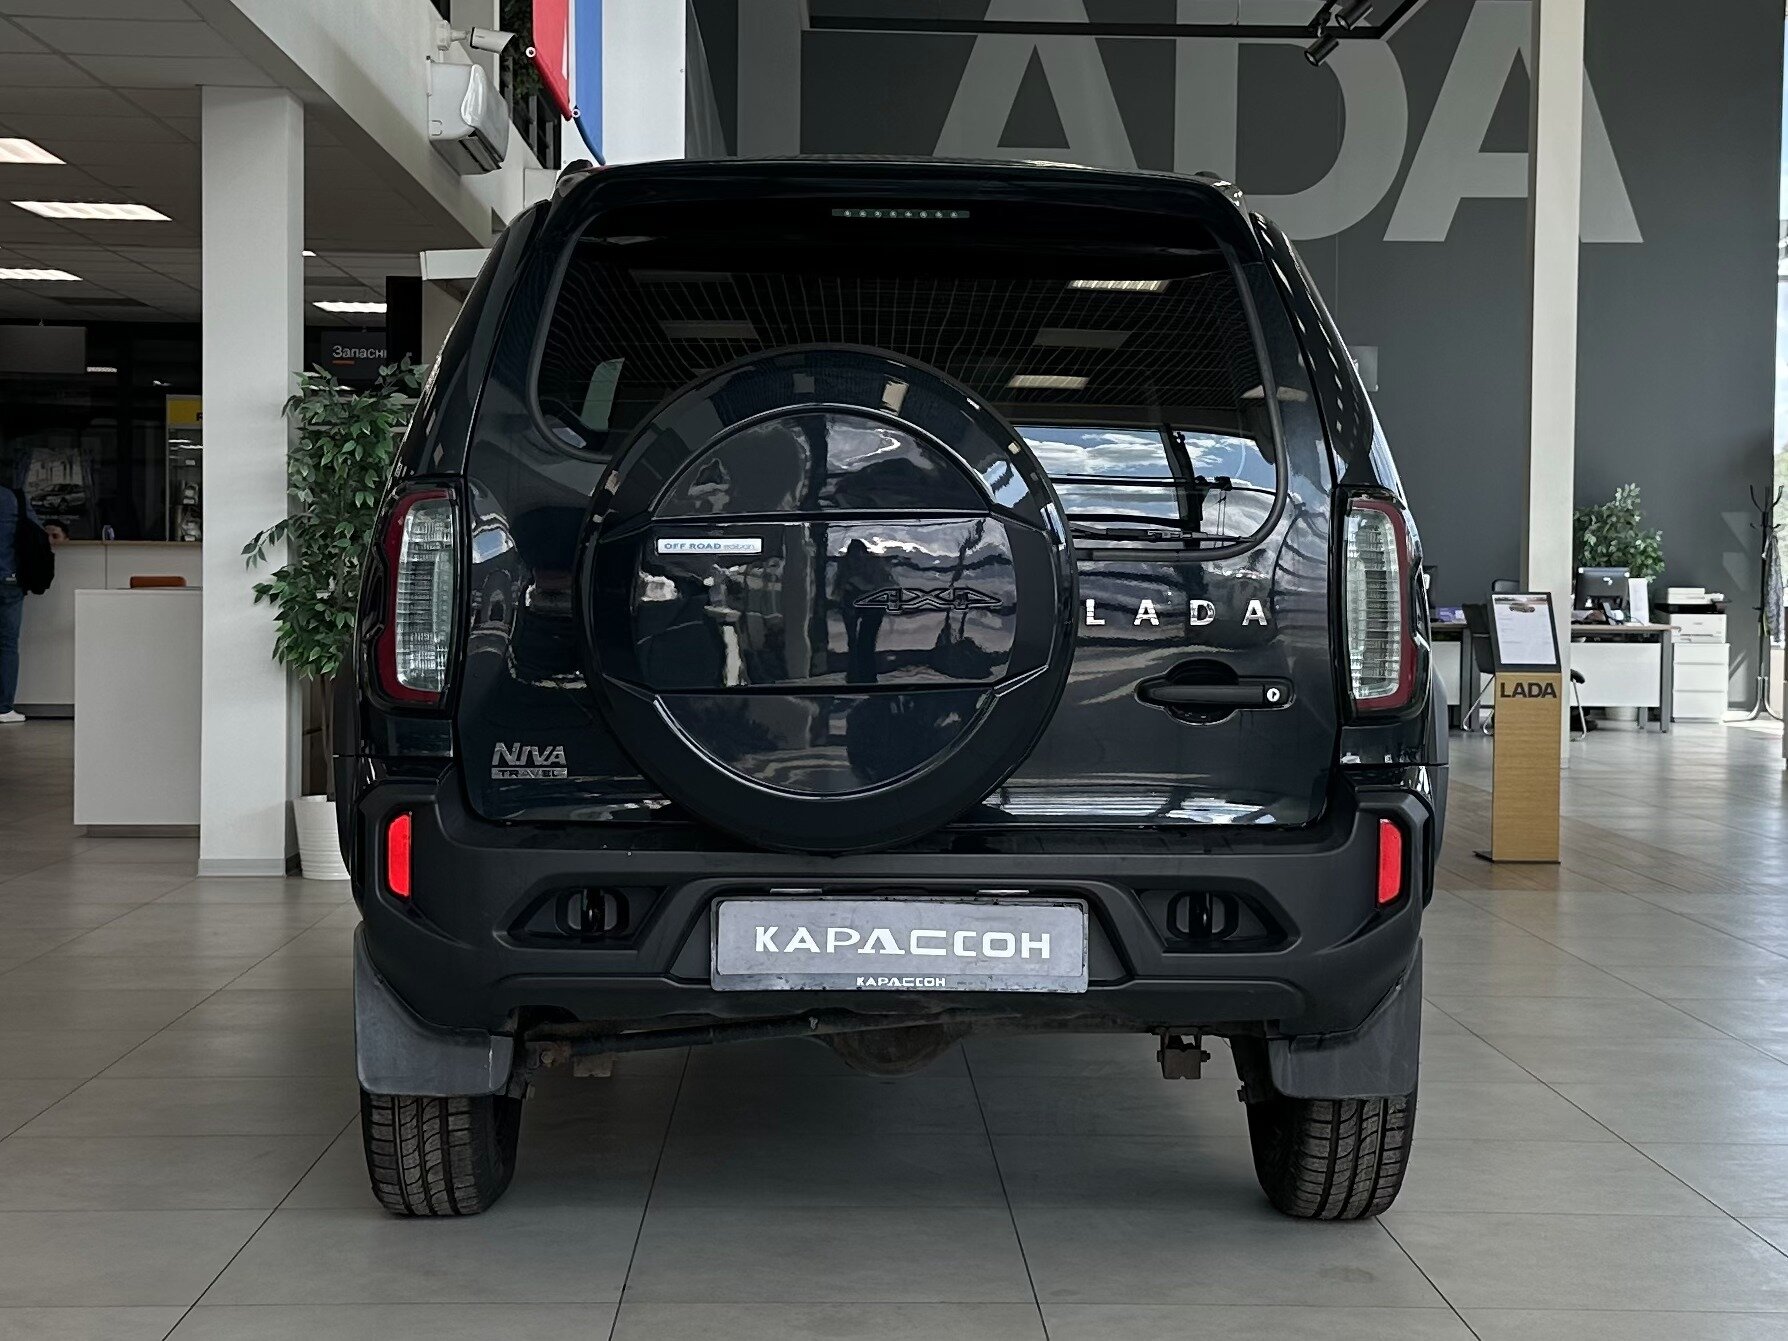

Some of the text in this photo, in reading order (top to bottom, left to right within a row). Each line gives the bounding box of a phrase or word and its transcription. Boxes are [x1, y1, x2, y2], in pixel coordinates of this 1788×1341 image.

[664, 542, 687, 550] OFF
[689, 542, 721, 550] ROAD
[1085, 598, 1268, 627] LADA
[1500, 682, 1557, 698] LADA
[492, 742, 567, 766] NIVA
